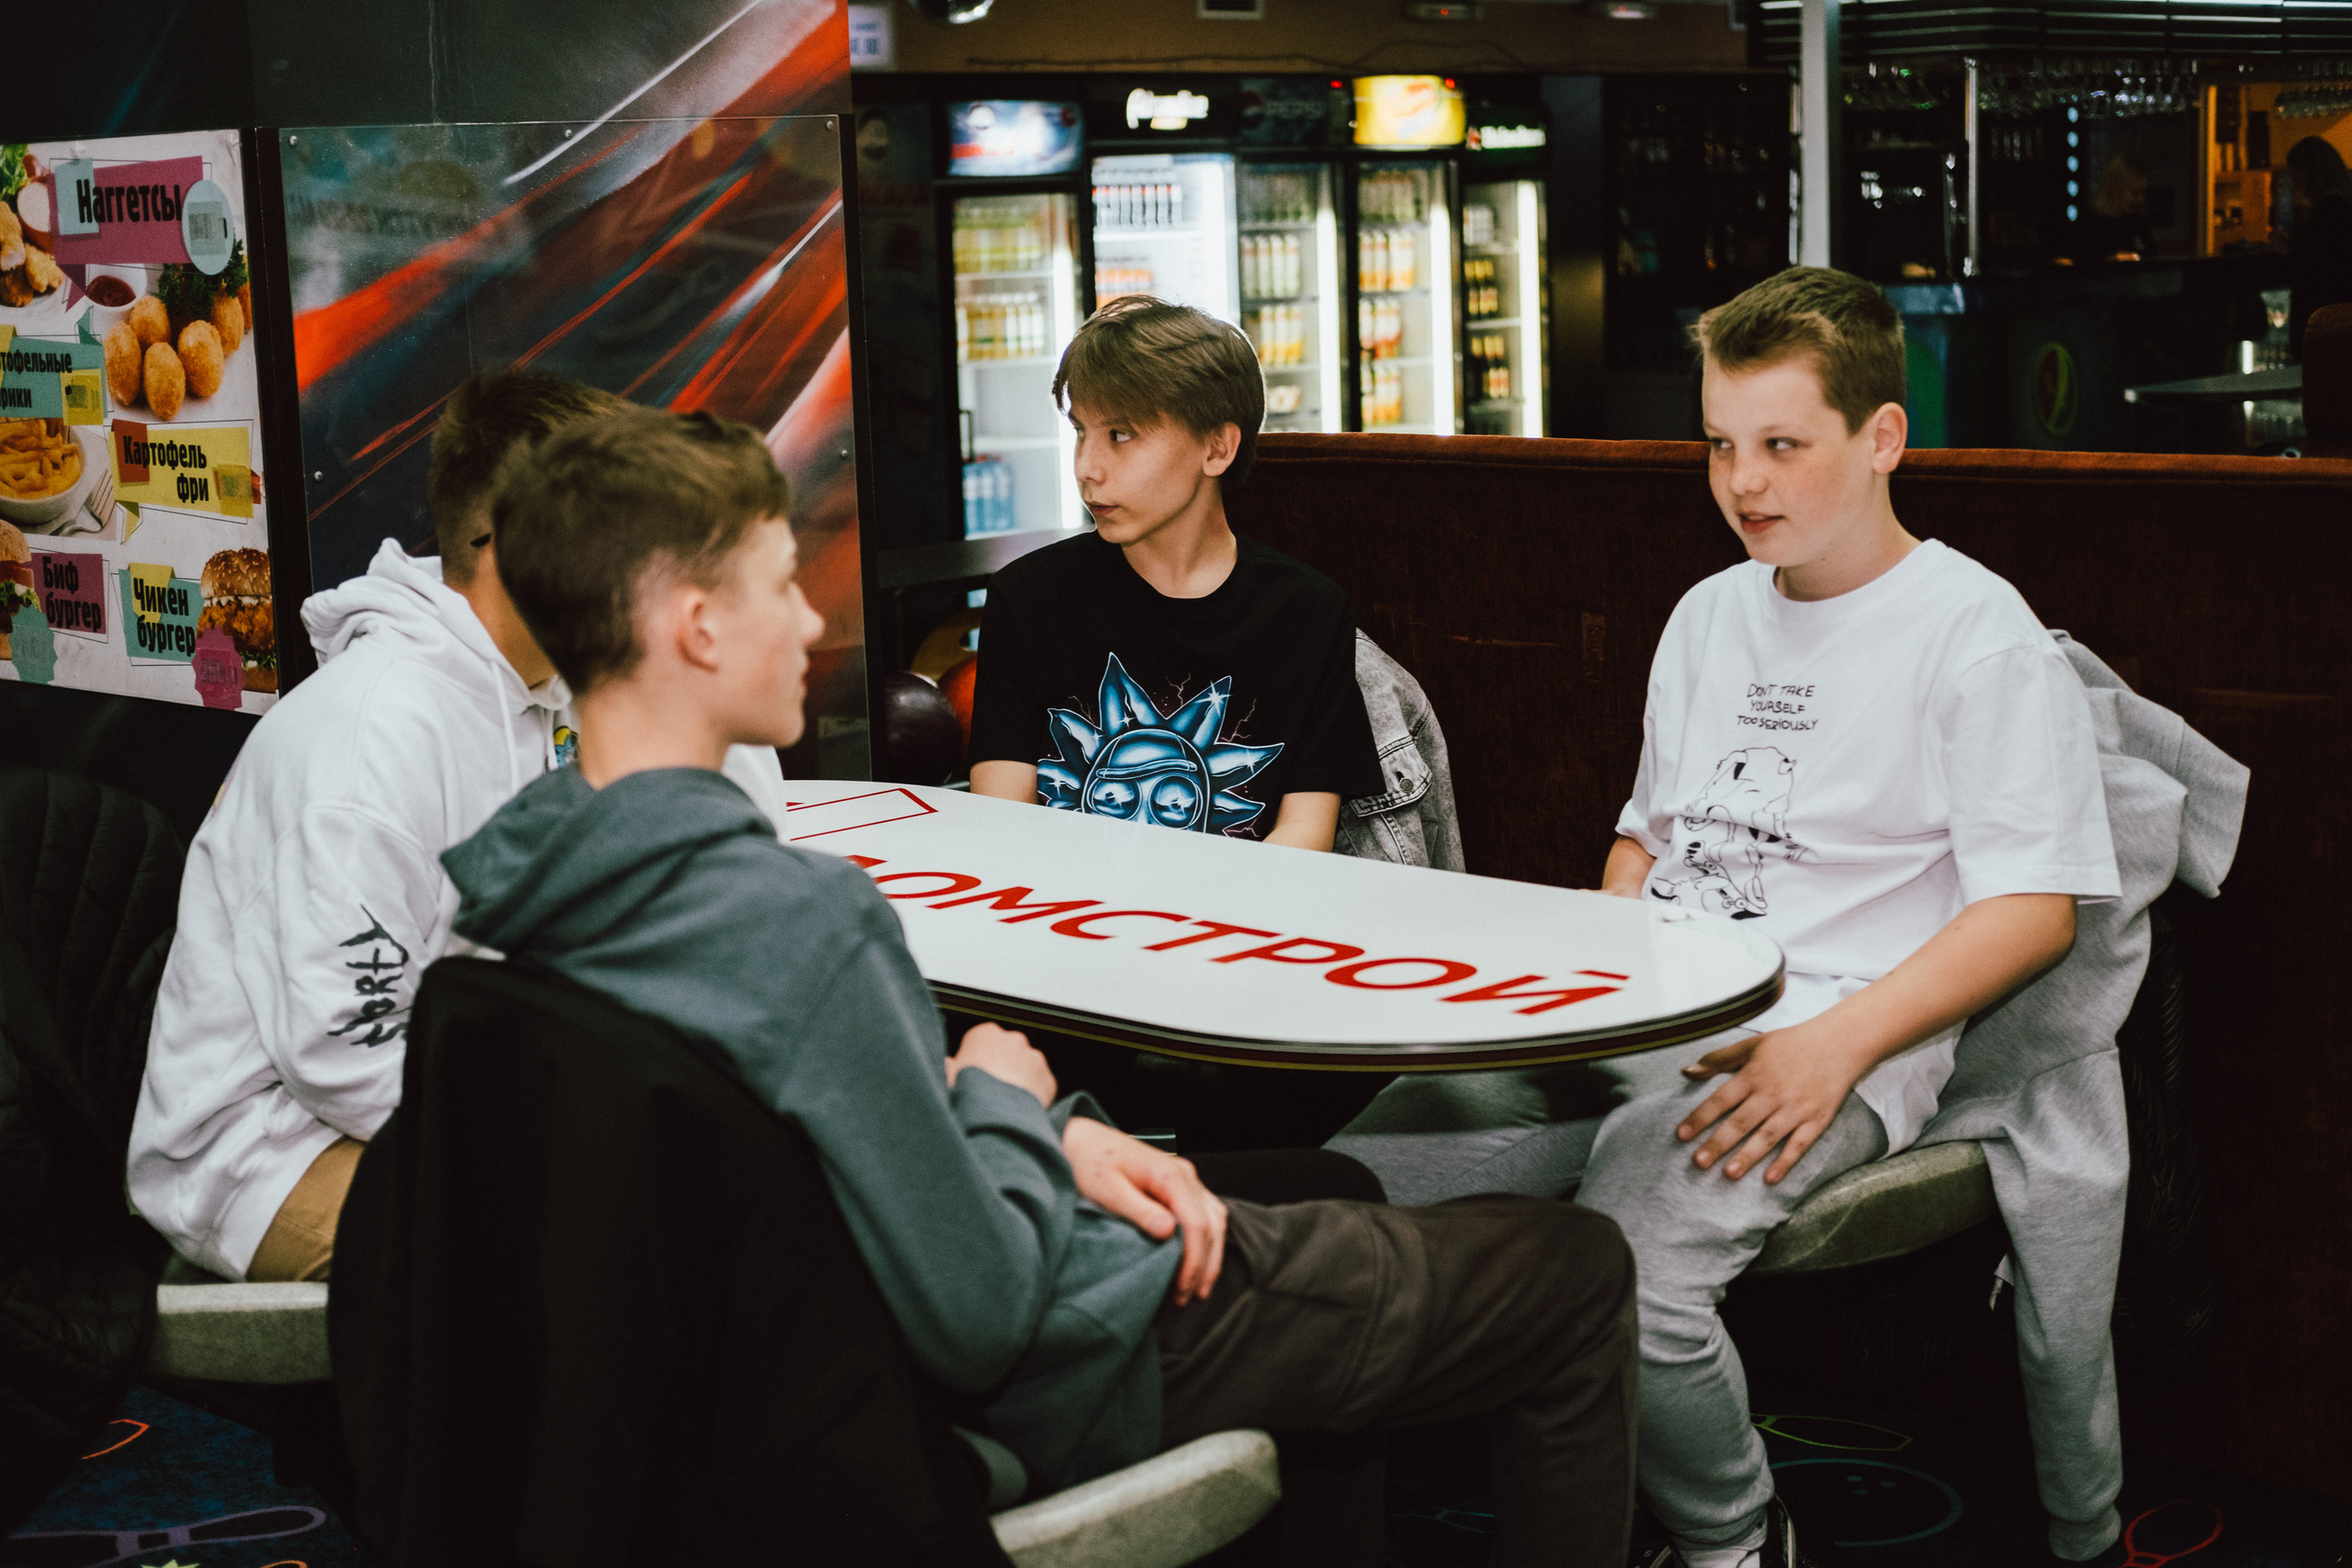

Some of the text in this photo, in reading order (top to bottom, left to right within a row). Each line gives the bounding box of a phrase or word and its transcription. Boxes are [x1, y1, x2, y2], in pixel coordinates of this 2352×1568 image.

[76, 178, 183, 223] Наггетсы
[0, 349, 73, 374] тофельные
[0, 388, 32, 410] рики
[123, 434, 207, 470] Картофель
[176, 473, 209, 503] фри
[42, 556, 79, 593] Биф
[45, 592, 101, 633] бургер
[133, 578, 189, 616] Чикен
[136, 615, 196, 658] бургер
[1750, 700, 1805, 715] YOURSELF
[1781, 685, 1815, 698] TAKE
[842, 854, 1631, 1015] ОМСТРОЙ
